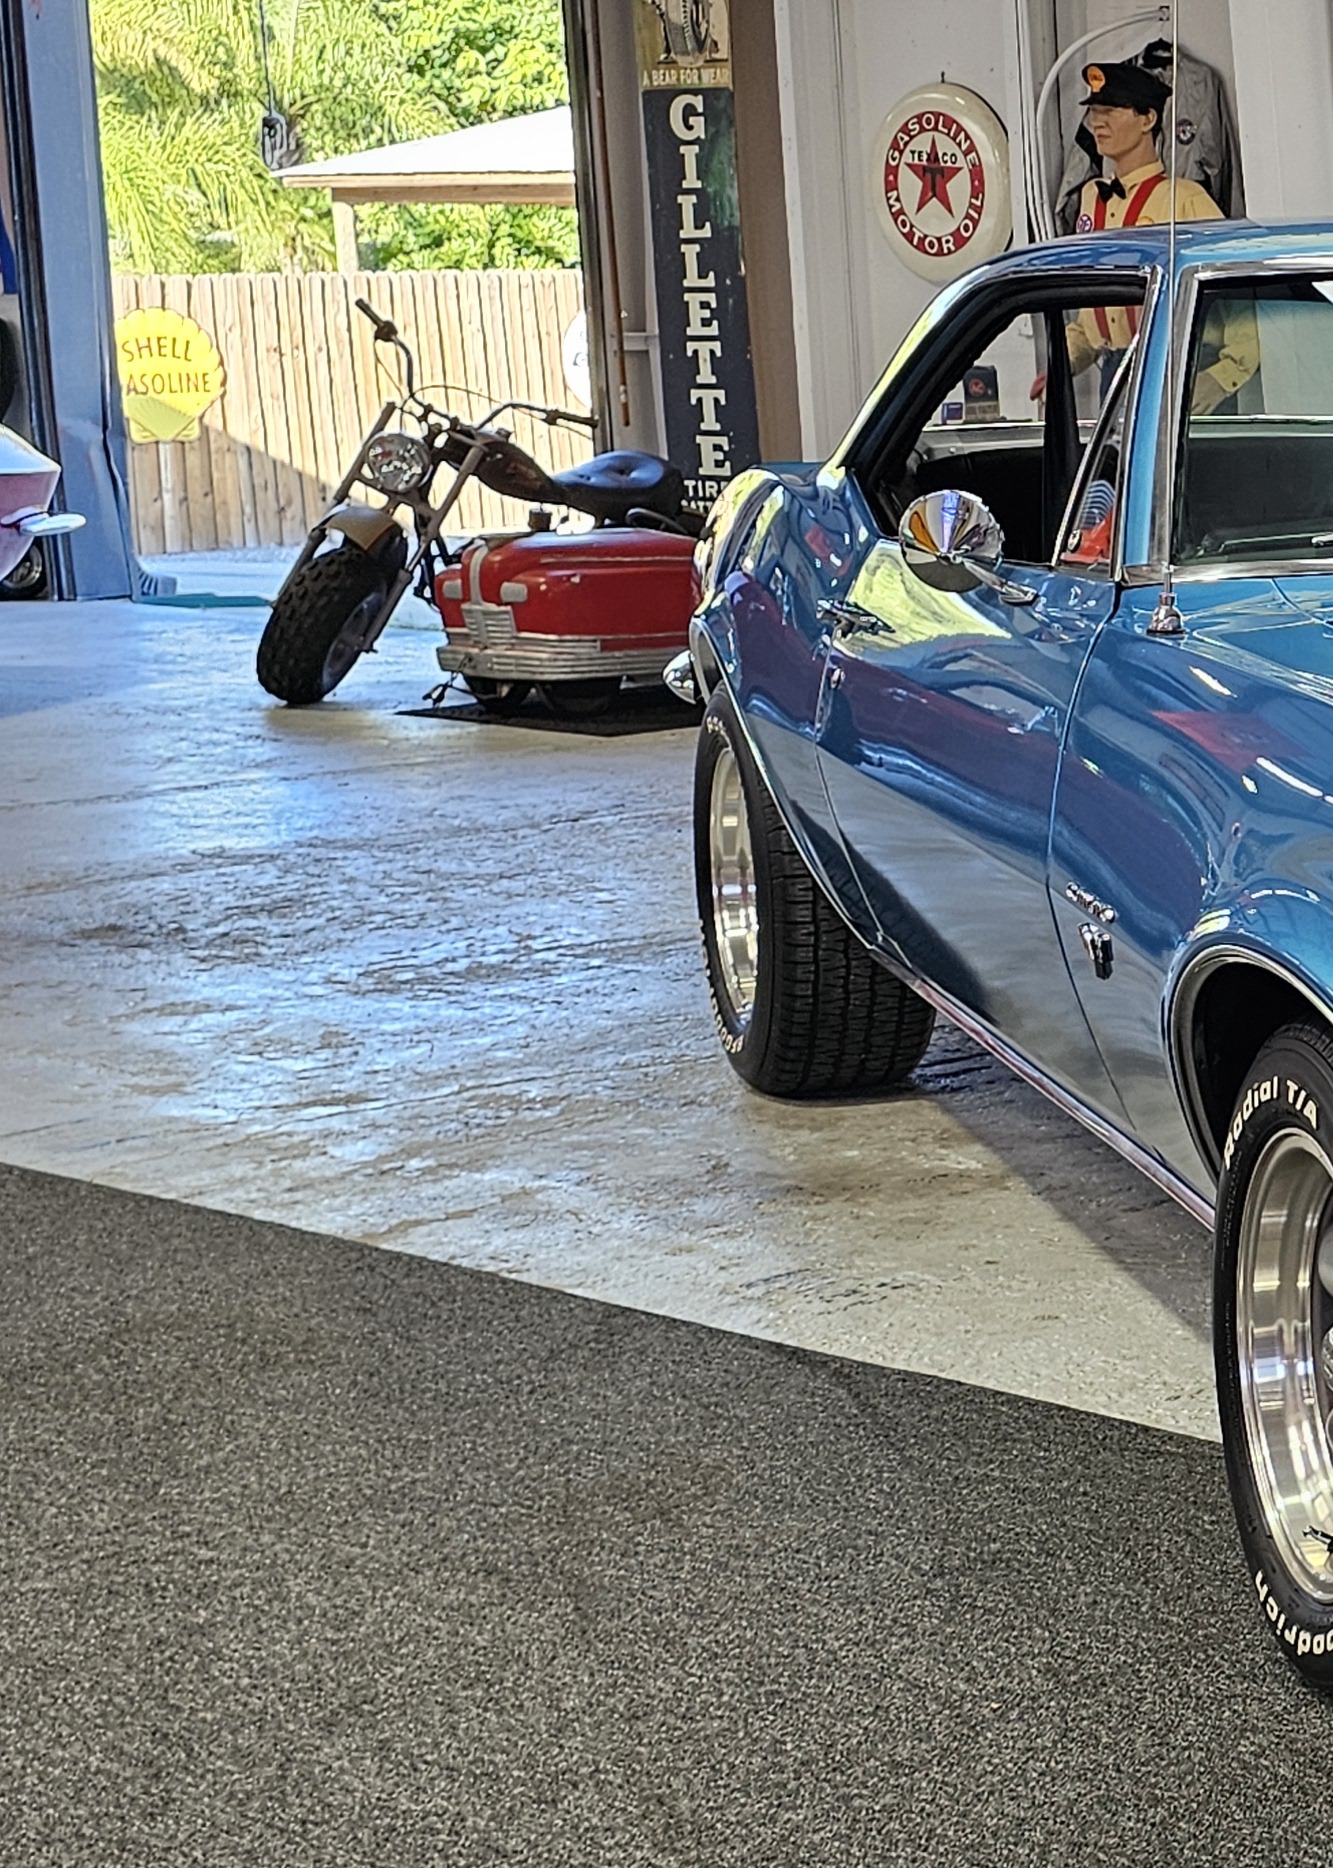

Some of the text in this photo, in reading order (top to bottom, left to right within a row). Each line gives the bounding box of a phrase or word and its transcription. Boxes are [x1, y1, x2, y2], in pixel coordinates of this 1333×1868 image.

[680, 69, 699, 84] FOR
[887, 113, 979, 169] GASOLINE
[910, 150, 958, 165] TEXACO
[887, 190, 982, 254] MOTOR OIL
[669, 93, 732, 476] GILLETTE
[121, 336, 192, 362] SHELL
[126, 372, 211, 396] ASOLINE
[1224, 1075, 1317, 1171] Radial T/A
